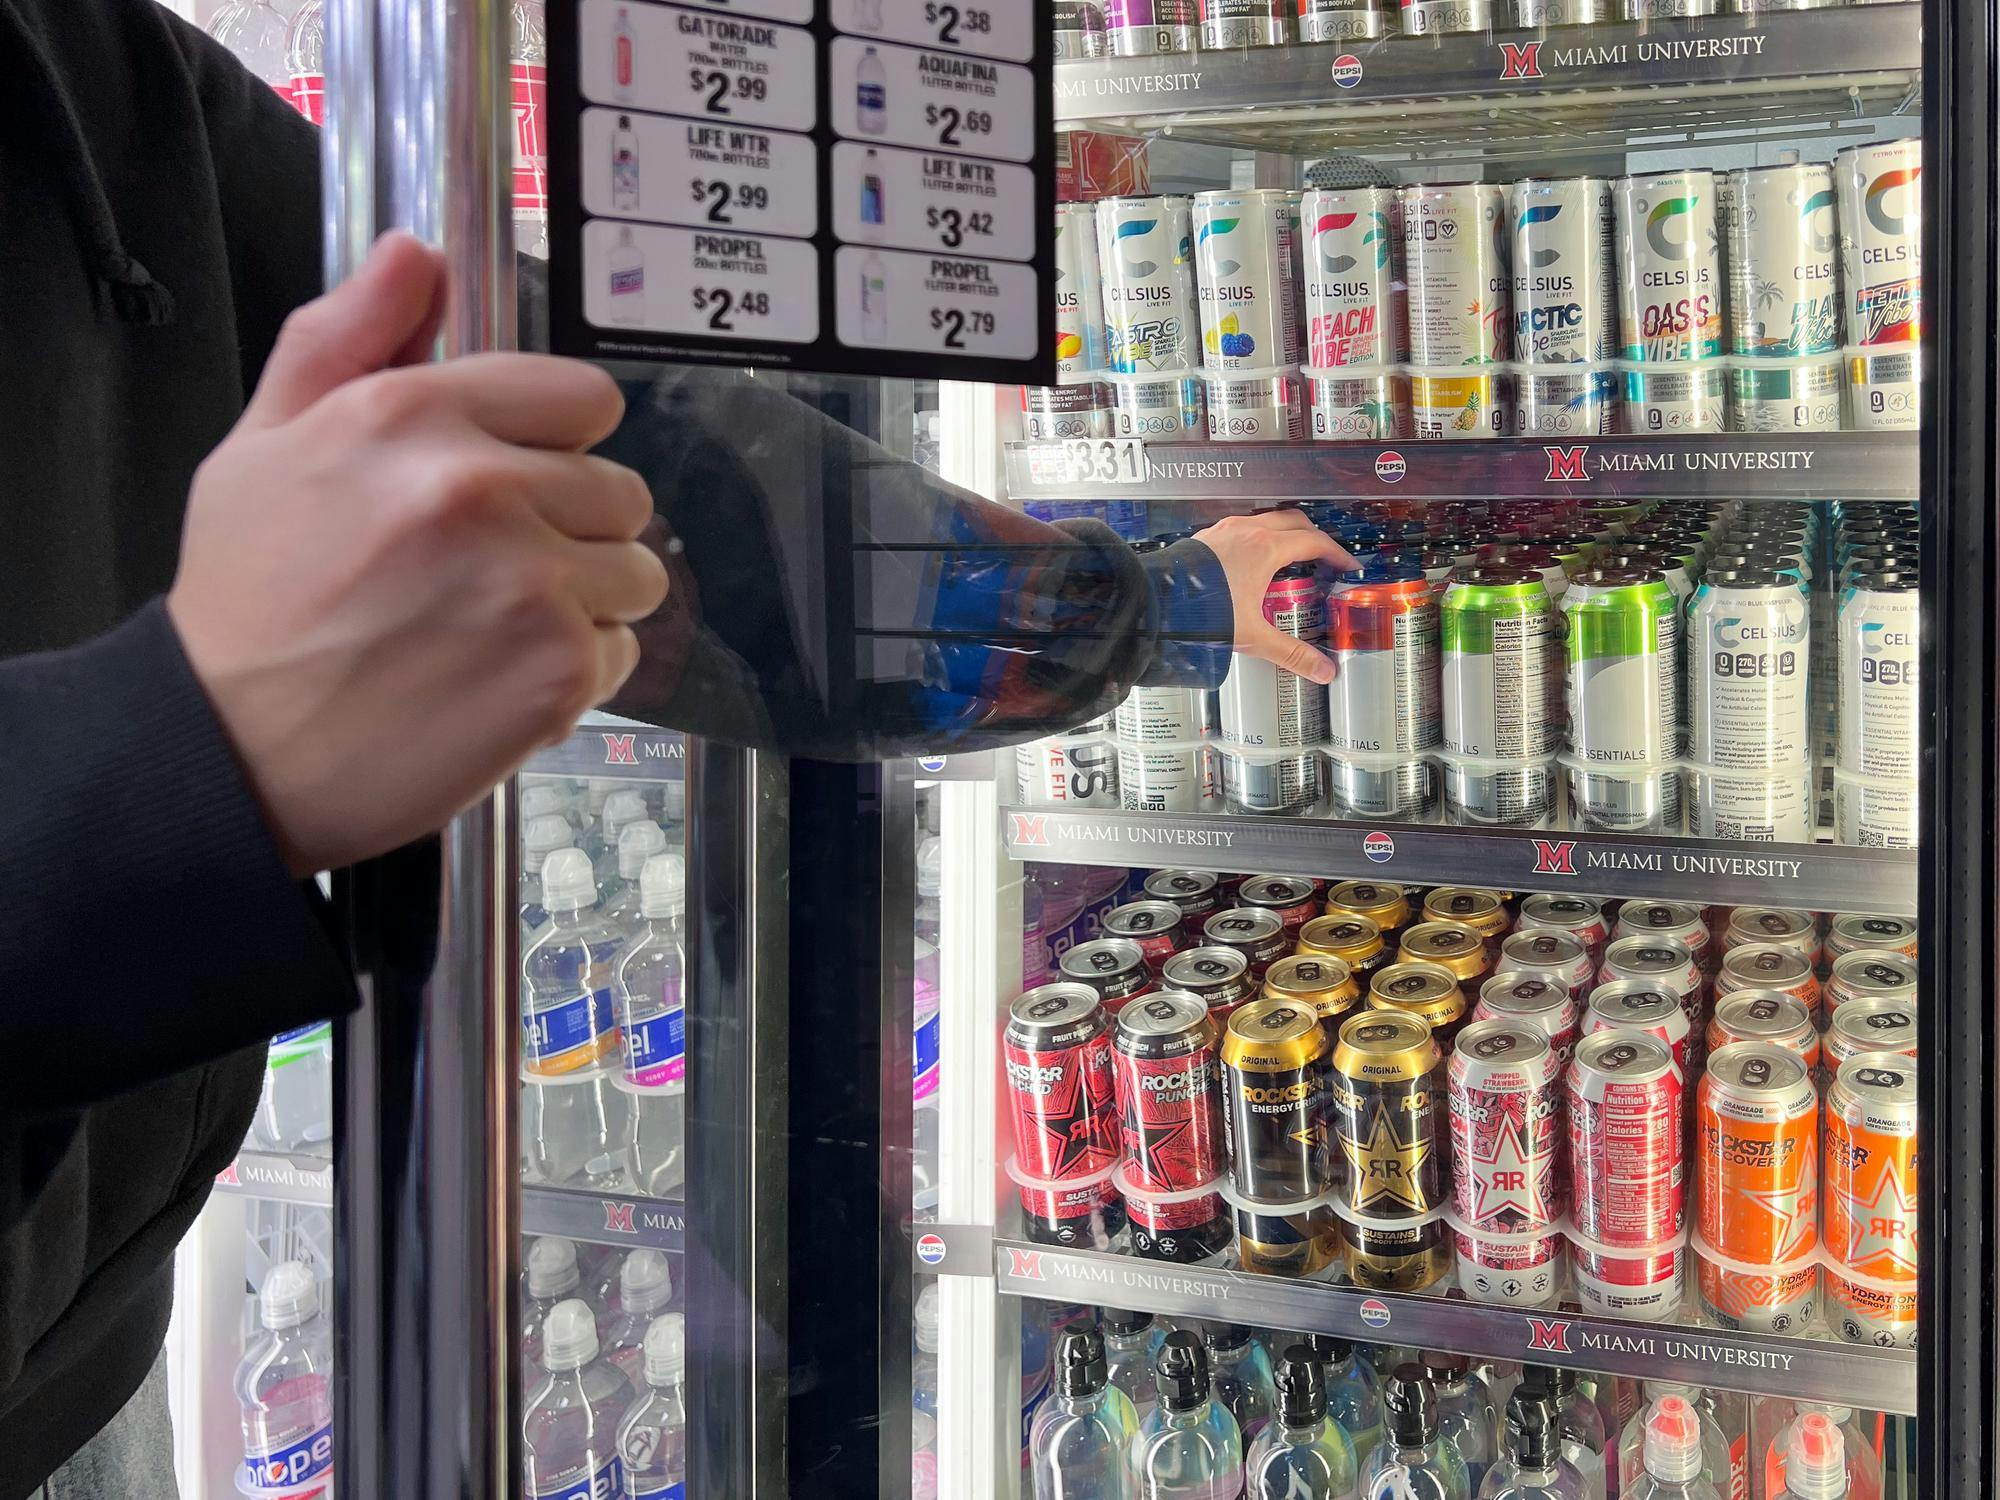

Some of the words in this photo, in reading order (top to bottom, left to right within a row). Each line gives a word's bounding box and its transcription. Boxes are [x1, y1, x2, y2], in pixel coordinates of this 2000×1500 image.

[678, 13, 776, 48] GATORADE
[925, 2, 992, 45] $2.38
[709, 41, 748, 56] WATER
[1553, 46, 1628, 68] MIAMI
[1638, 36, 1766, 62] UNIVERSITY
[721, 56, 768, 74] BOTTLES
[918, 55, 998, 83] AQUAFINA
[1498, 41, 1545, 80] M
[1333, 66, 1362, 77] PEPSI
[690, 69, 768, 115] $2.99
[928, 77, 953, 91] LITER
[954, 79, 996, 96] BOTTLES
[1095, 73, 1202, 95] UNIVERSITY
[925, 104, 993, 146] $2.69
[687, 126, 726, 150] LIFE
[730, 132, 771, 154] WTR
[722, 150, 770, 169] BOTTLES
[924, 158, 957, 179] LIFE
[960, 163, 995, 183] WTR
[929, 179, 954, 193] LITER
[955, 182, 997, 197] BOTTLES
[690, 179, 768, 224] $2.99
[926, 207, 994, 249] $3.42
[694, 236, 766, 260] PROPEL
[720, 258, 768, 275] BOTTLES
[931, 260, 992, 282] PROPEL
[930, 280, 956, 293] LITER
[957, 282, 998, 297] BOTTLES
[1311, 283, 1368, 297] CELSIUS
[1516, 277, 1572, 291] CELSIUS
[692, 286, 770, 331] $2.48
[1642, 295, 1709, 339] OASIS
[930, 308, 995, 349] $2.79
[1312, 305, 1376, 344] PEACH
[1515, 303, 1582, 336] ARCTIC
[1312, 338, 1351, 368] VIBE
[1350, 353, 1374, 364] EDITION
[1152, 462, 1244, 478] NIVERSITY
[1376, 463, 1404, 471] PEPSI
[1543, 446, 1591, 481] M
[1599, 454, 1674, 472] MIAMI
[1685, 451, 1814, 470] UNIVERSITY
[1741, 625, 1796, 639] CELSIUS
[1579, 748, 1645, 760] ESSENTIALS
[1011, 814, 1051, 846] M
[1058, 824, 1120, 842] MIAMI
[1127, 827, 1235, 847] UNIVERSITY
[1364, 842, 1393, 851] PEPSI
[1531, 839, 1577, 875] M
[1587, 851, 1663, 871] MIAMI
[1673, 855, 1802, 879] UNIVERSITY
[1105, 984, 1122, 993] FRUIT
[1203, 992, 1220, 1001] FRUIT
[1222, 984, 1242, 998] PUNCH
[1316, 995, 1349, 1011] ORIGINAL
[1052, 1033, 1072, 1044] FRUIT
[1074, 1024, 1094, 1040] PUNCH
[1163, 1042, 1183, 1051] FRUIT
[1184, 1032, 1203, 1048] PUNCH
[1241, 1055, 1280, 1066] ORIGINAL
[1362, 1066, 1402, 1075] ORIGINAL
[1251, 1103, 1294, 1115] ENERGY
[1607, 1093, 1644, 1105] Nutrition
[1723, 1100, 1764, 1114] ORANGEADE
[1607, 1125, 1642, 1134] Calories
[1707, 1142, 1789, 1169] RECOVERY
[246, 1167, 294, 1185] MIAMI
[1363, 1229, 1415, 1240] SUSTAINS
[919, 1243, 944, 1254] PEPSI
[1008, 1248, 1046, 1280] M
[1052, 1262, 1116, 1285] MIAMI
[1123, 1271, 1230, 1299] UNIVERSITY
[1843, 1281, 1916, 1304] HYDRATION
[1852, 1295, 1885, 1309] ENERGY
[1362, 1307, 1390, 1319] PEPSI
[1526, 1317, 1573, 1354] M
[1580, 1333, 1656, 1355] MIAMI
[1665, 1340, 1794, 1371] UNIVERSITY
